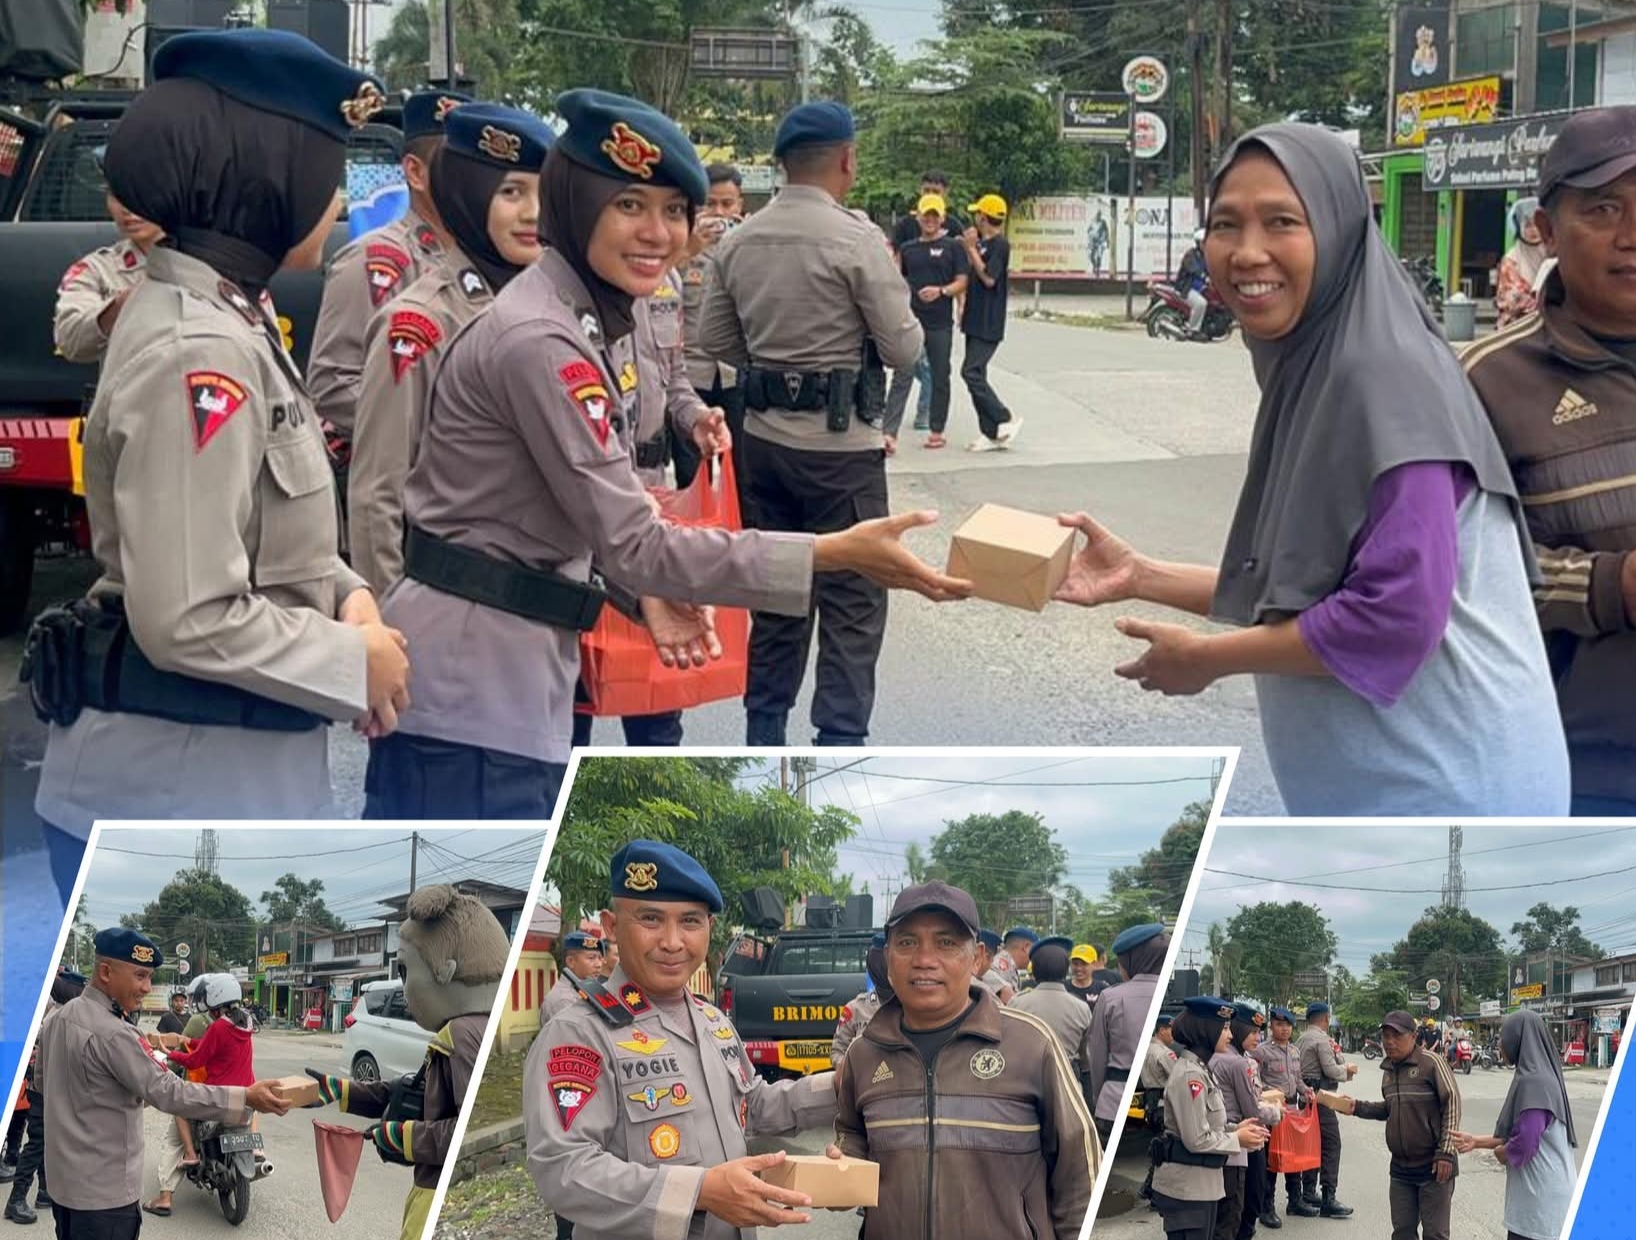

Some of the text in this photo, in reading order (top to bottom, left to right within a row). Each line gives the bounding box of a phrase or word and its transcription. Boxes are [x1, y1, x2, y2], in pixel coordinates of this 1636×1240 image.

[553, 1047, 600, 1064] PELOPOR
[551, 1061, 595, 1077] GEGANA
[622, 1058, 680, 1079] YOGIE
